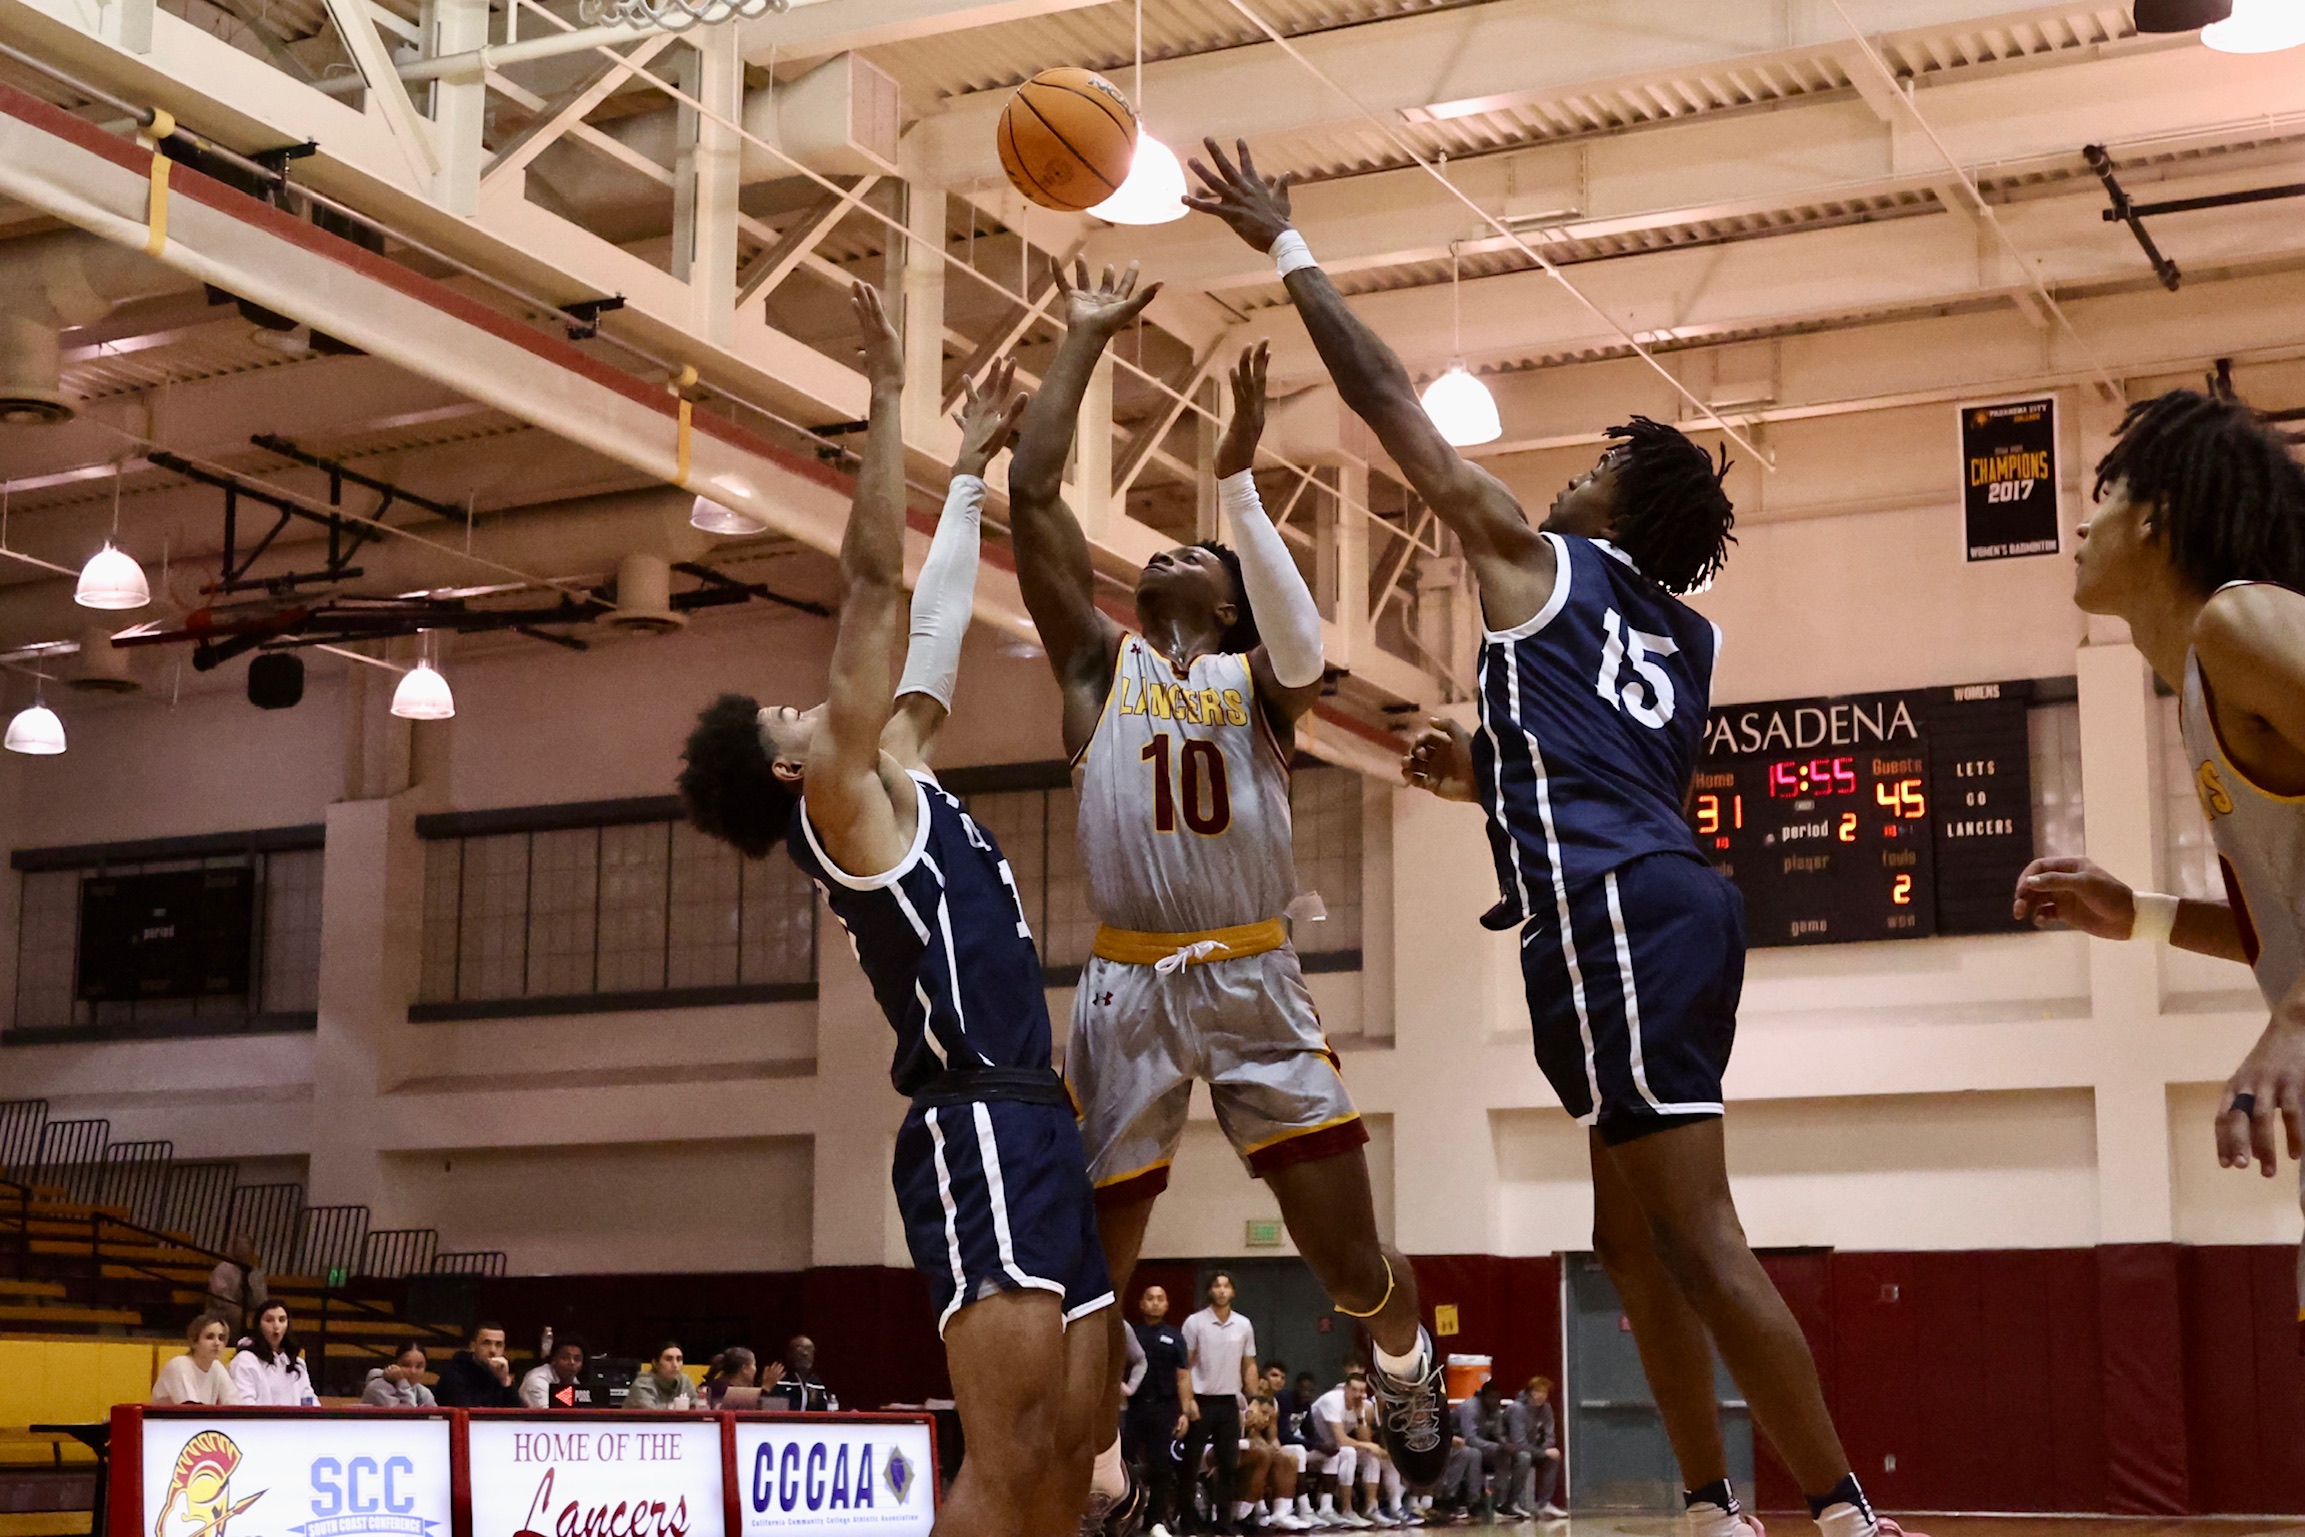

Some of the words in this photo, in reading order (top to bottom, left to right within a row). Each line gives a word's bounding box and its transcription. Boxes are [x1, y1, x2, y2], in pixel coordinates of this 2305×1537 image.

[1970, 451, 2049, 487] CHAMPIONS
[1988, 479, 2034, 504] 2017
[1594, 606, 1680, 730] 15
[1119, 677, 1249, 727] LANCERS
[1954, 684, 2001, 701] WOMENS
[1769, 757, 1857, 798] 15:55
[1872, 757, 1923, 776] Guests
[1956, 760, 1996, 778] LETS
[1141, 732, 1232, 838] 10
[1876, 779, 1926, 819] 45
[1966, 791, 1987, 807] GO
[1697, 794, 1742, 834] 31
[1781, 820, 1829, 842] period
[1838, 812, 1857, 842] 2
[1946, 819, 2013, 838] LANCERS
[1893, 874, 1912, 905] 2
[513, 1432, 590, 1462] HOME
[598, 1432, 630, 1462] OF
[634, 1432, 683, 1461] THE
[310, 1455, 415, 1518] SCC
[752, 1441, 875, 1513] CCCAA
[512, 1467, 692, 1537] Lancers
[307, 1520, 338, 1537] SOUTH
[339, 1518, 368, 1532] COAST
[368, 1517, 421, 1533] CONFERENCE
